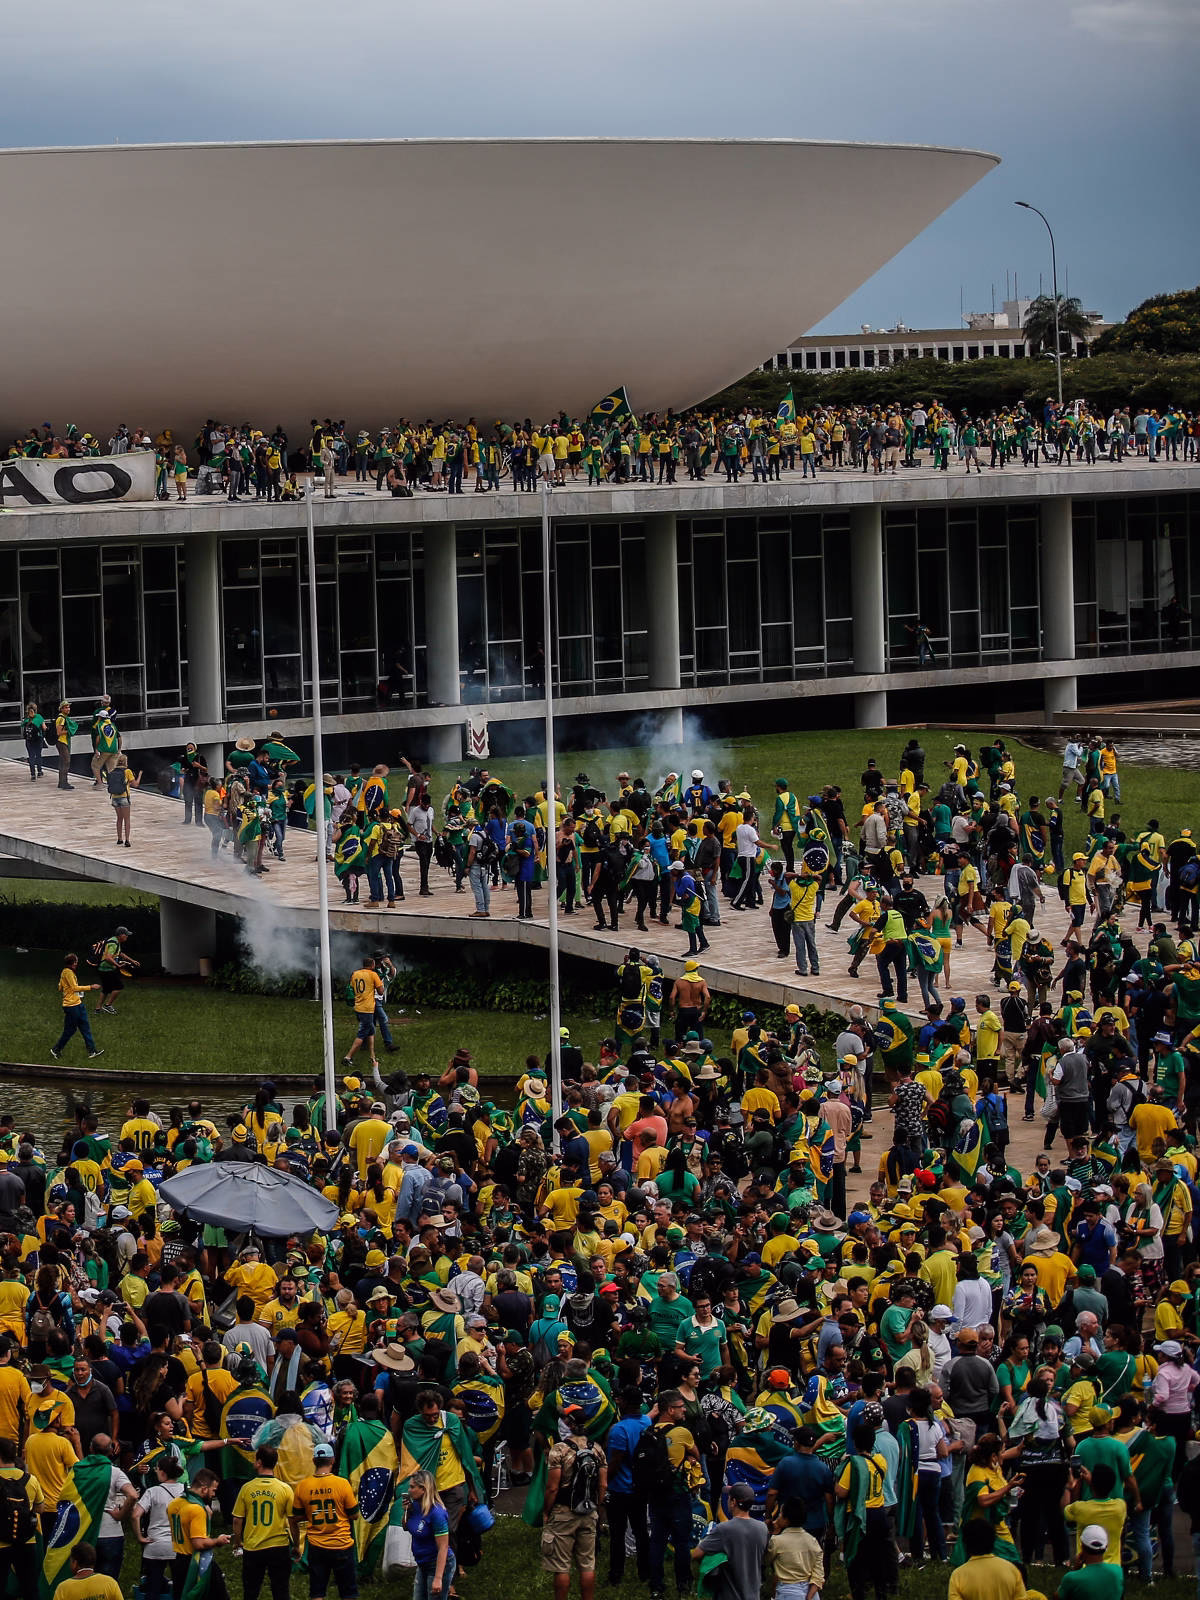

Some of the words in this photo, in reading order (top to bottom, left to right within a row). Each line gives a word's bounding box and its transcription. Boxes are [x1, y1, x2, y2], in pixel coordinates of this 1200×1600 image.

[355, 978, 366, 993] 10
[133, 1129, 151, 1151] 10
[83, 1173, 96, 1191] 10
[250, 1489, 277, 1499] BRASIL
[309, 1487, 332, 1496] FABIO
[251, 1500, 274, 1527] 10
[309, 1498, 339, 1525] 20
